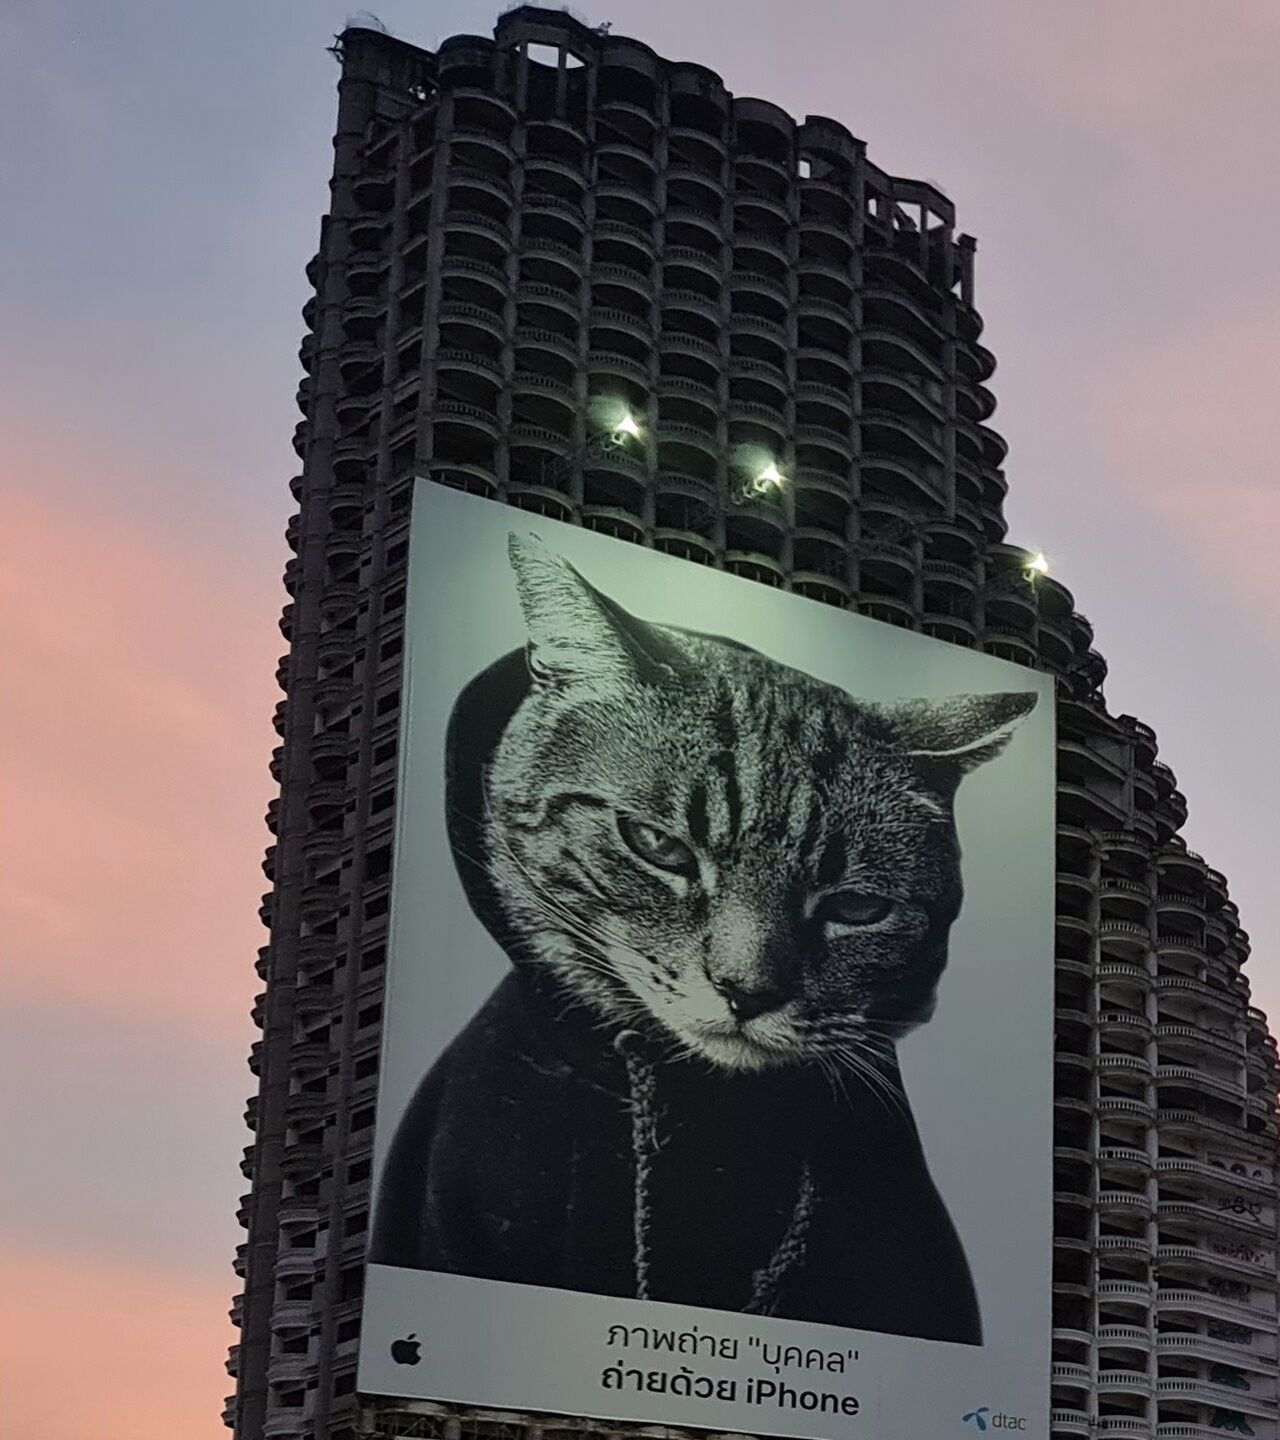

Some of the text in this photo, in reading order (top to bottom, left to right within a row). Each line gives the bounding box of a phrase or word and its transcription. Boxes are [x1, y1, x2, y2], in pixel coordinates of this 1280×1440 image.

[607, 1325, 859, 1374] ภาพถ่าย "บุคคล"
[601, 1360, 860, 1415] ถ่ายด้วย iPhone
[992, 1412, 1027, 1430] dtac
